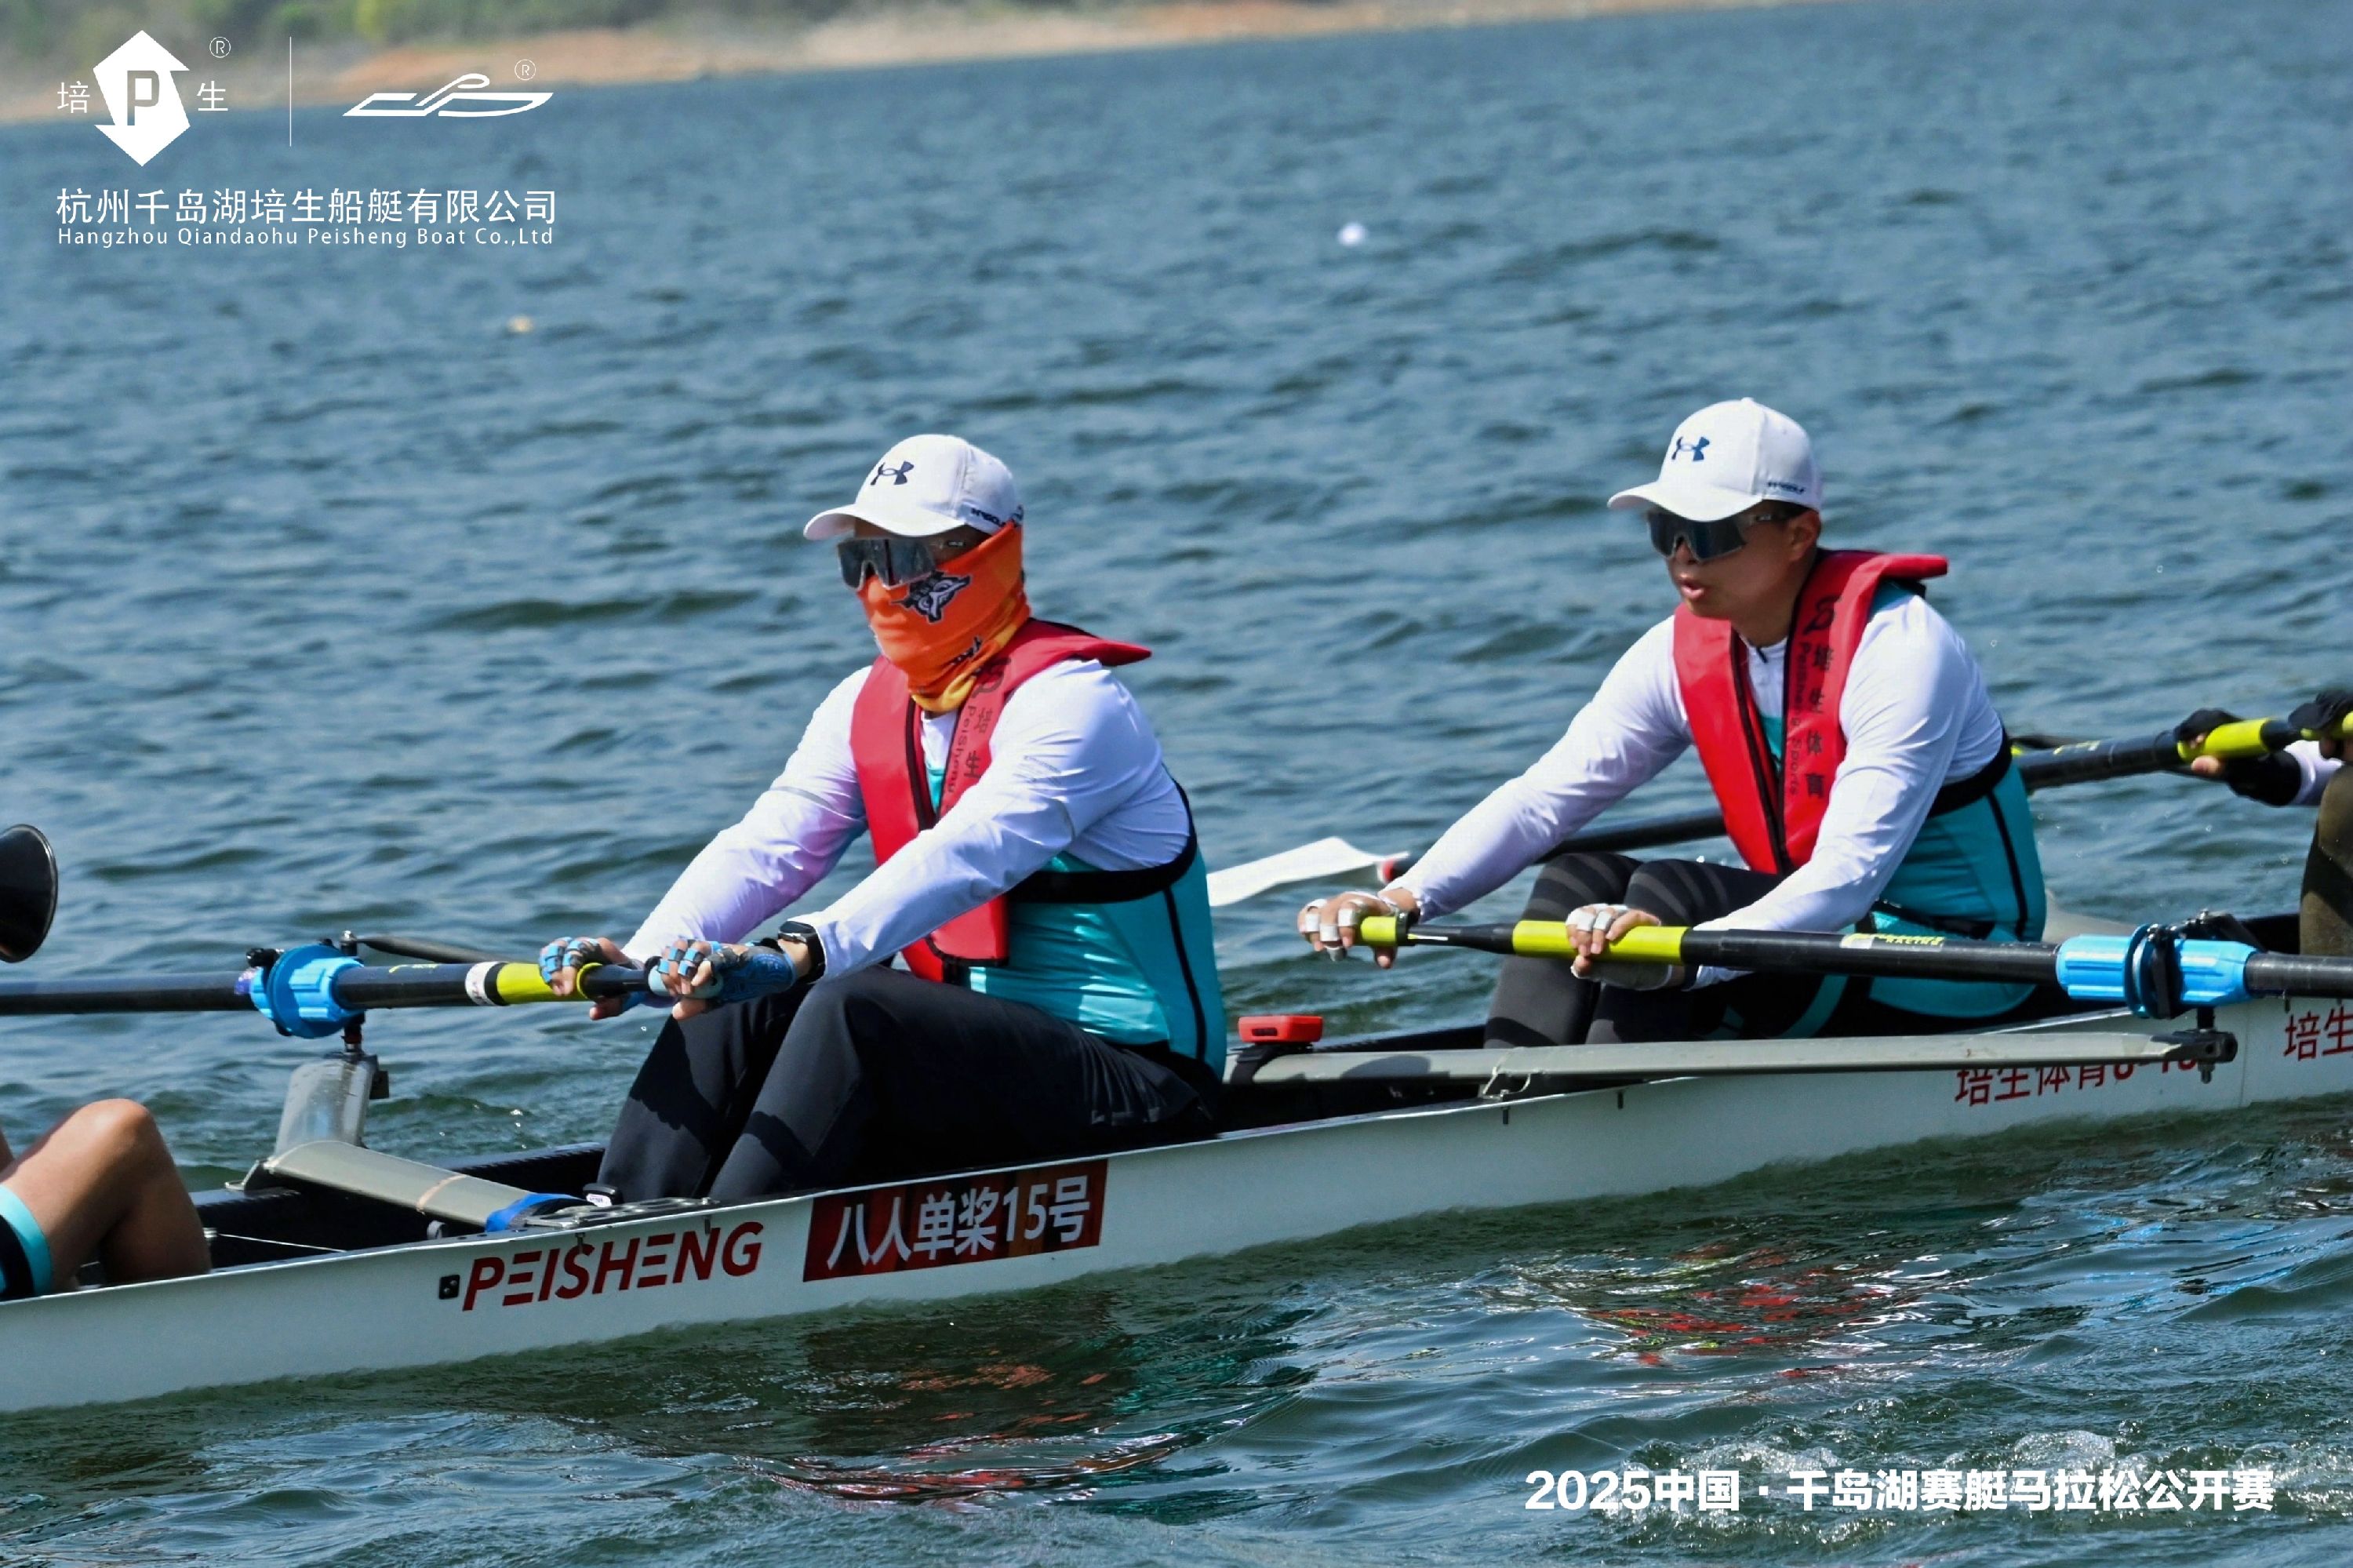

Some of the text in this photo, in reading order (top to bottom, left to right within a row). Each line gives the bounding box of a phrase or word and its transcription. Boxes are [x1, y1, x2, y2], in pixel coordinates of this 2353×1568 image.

[2283, 1006, 2352, 1061] 培生
[462, 1221, 763, 1312] PEISHENG
[827, 1175, 1089, 1270] 八人单桨15号
